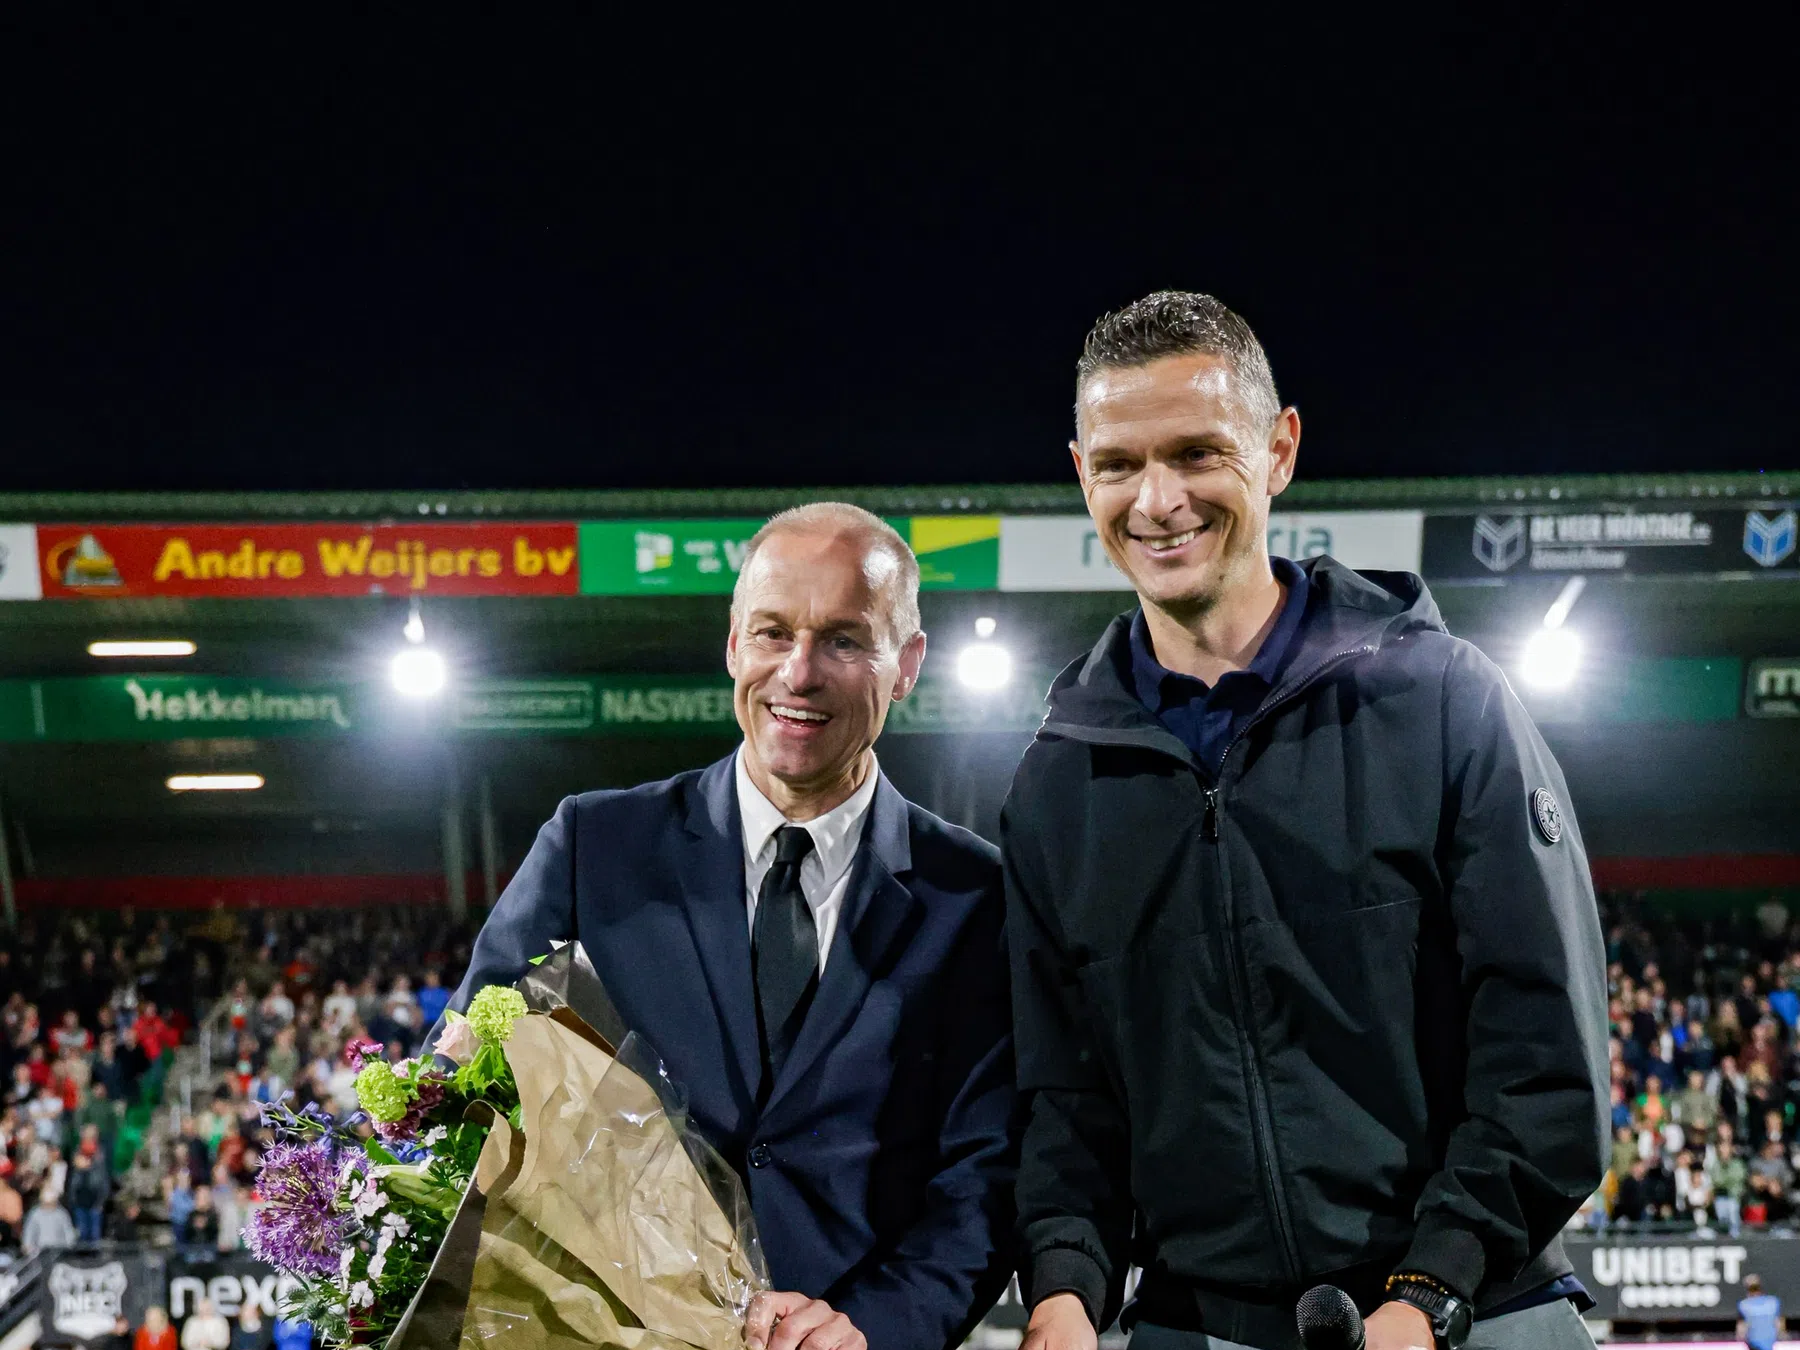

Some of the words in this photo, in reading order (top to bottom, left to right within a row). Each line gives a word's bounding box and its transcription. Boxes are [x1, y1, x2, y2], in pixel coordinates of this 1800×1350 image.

[317, 535, 501, 590] Weijers
[513, 536, 576, 576] bv
[1592, 1246, 1747, 1286] UNIBET
